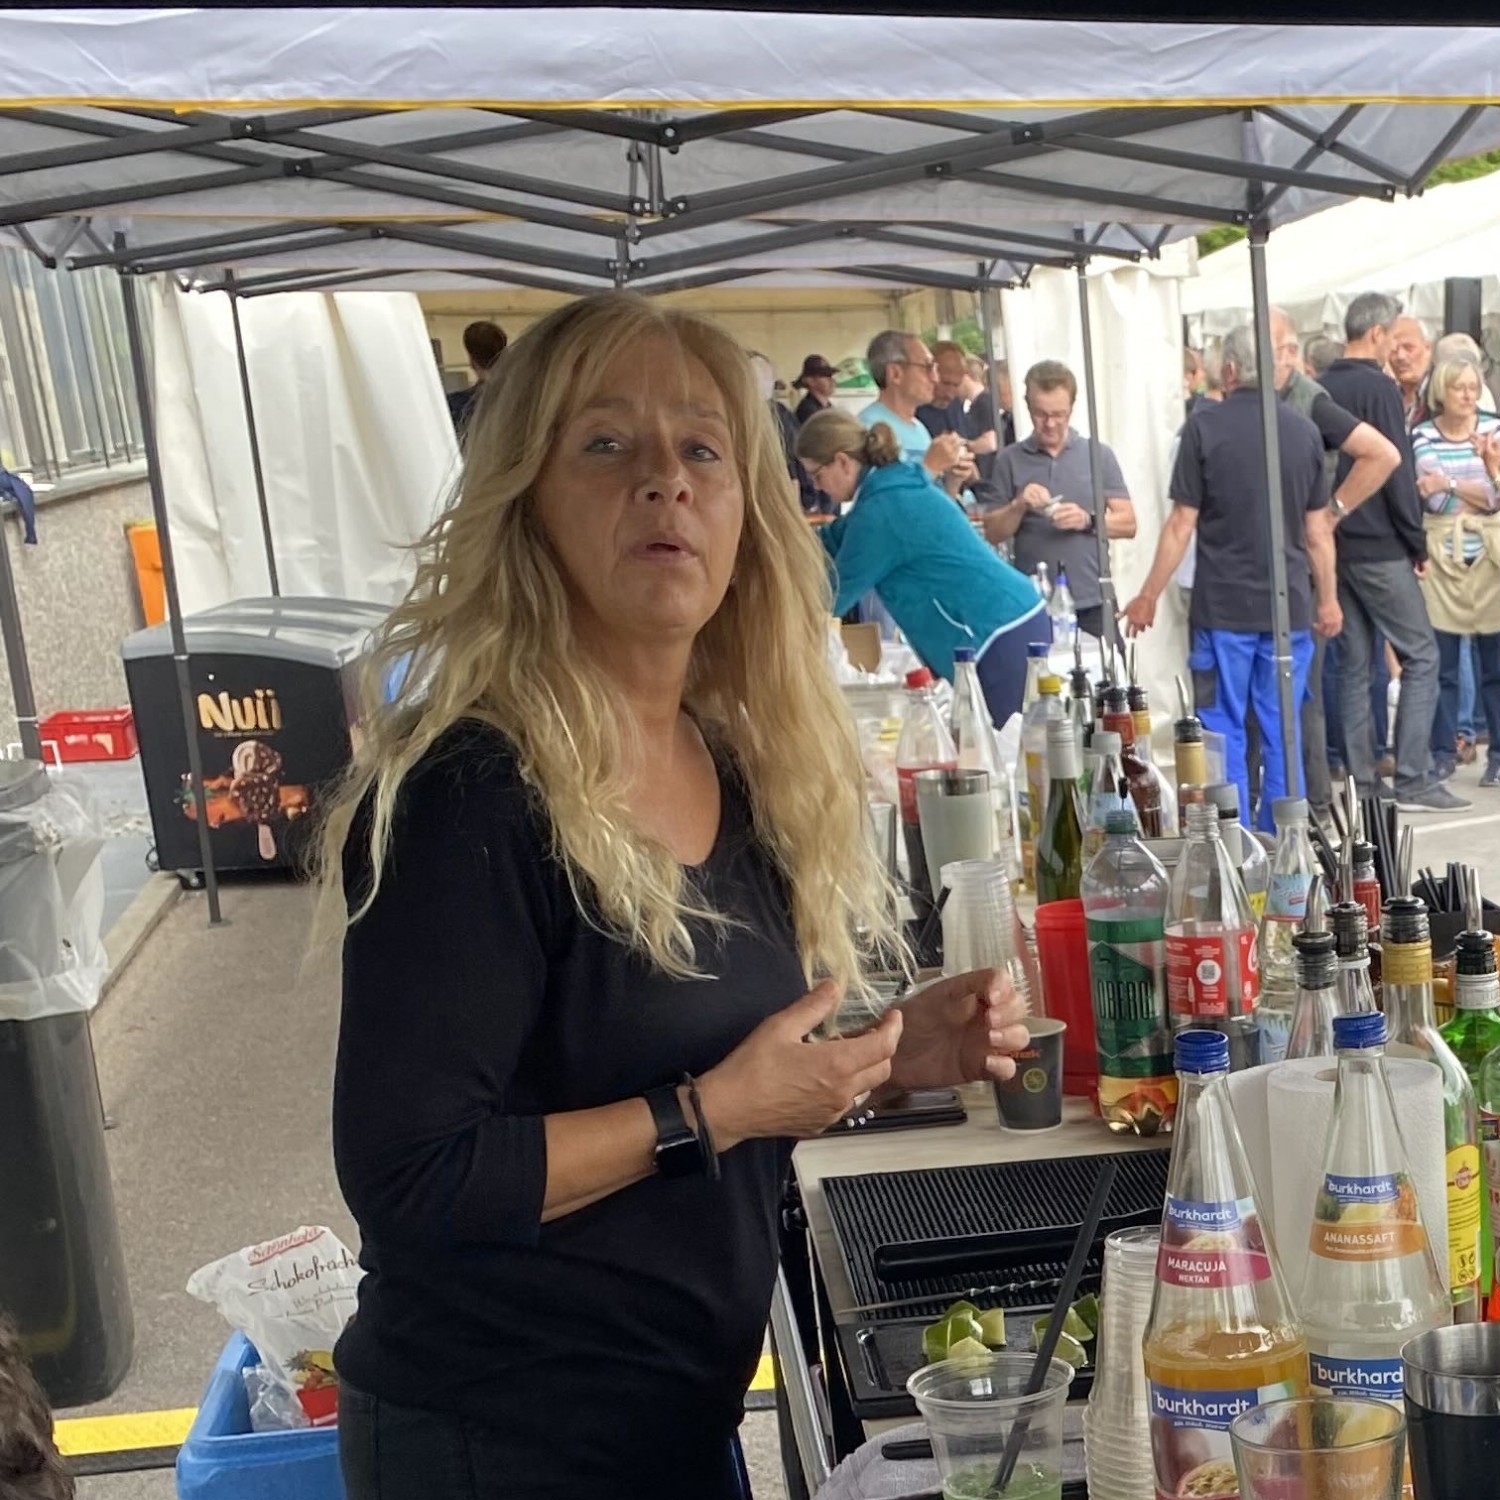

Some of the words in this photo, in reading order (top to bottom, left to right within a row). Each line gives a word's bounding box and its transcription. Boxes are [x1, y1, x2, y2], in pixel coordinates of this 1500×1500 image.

[197, 688, 282, 731] Nuii
[1328, 1181, 1393, 1195] burkhardt
[1167, 1205, 1233, 1221] burkhardt
[1323, 1232, 1397, 1245] ANANASSAFT
[1168, 1256, 1227, 1272] MARACUJA
[1178, 1273, 1210, 1284] NEKTAR
[1317, 1363, 1403, 1384] burkhard
[1157, 1392, 1249, 1416] burkhardt
